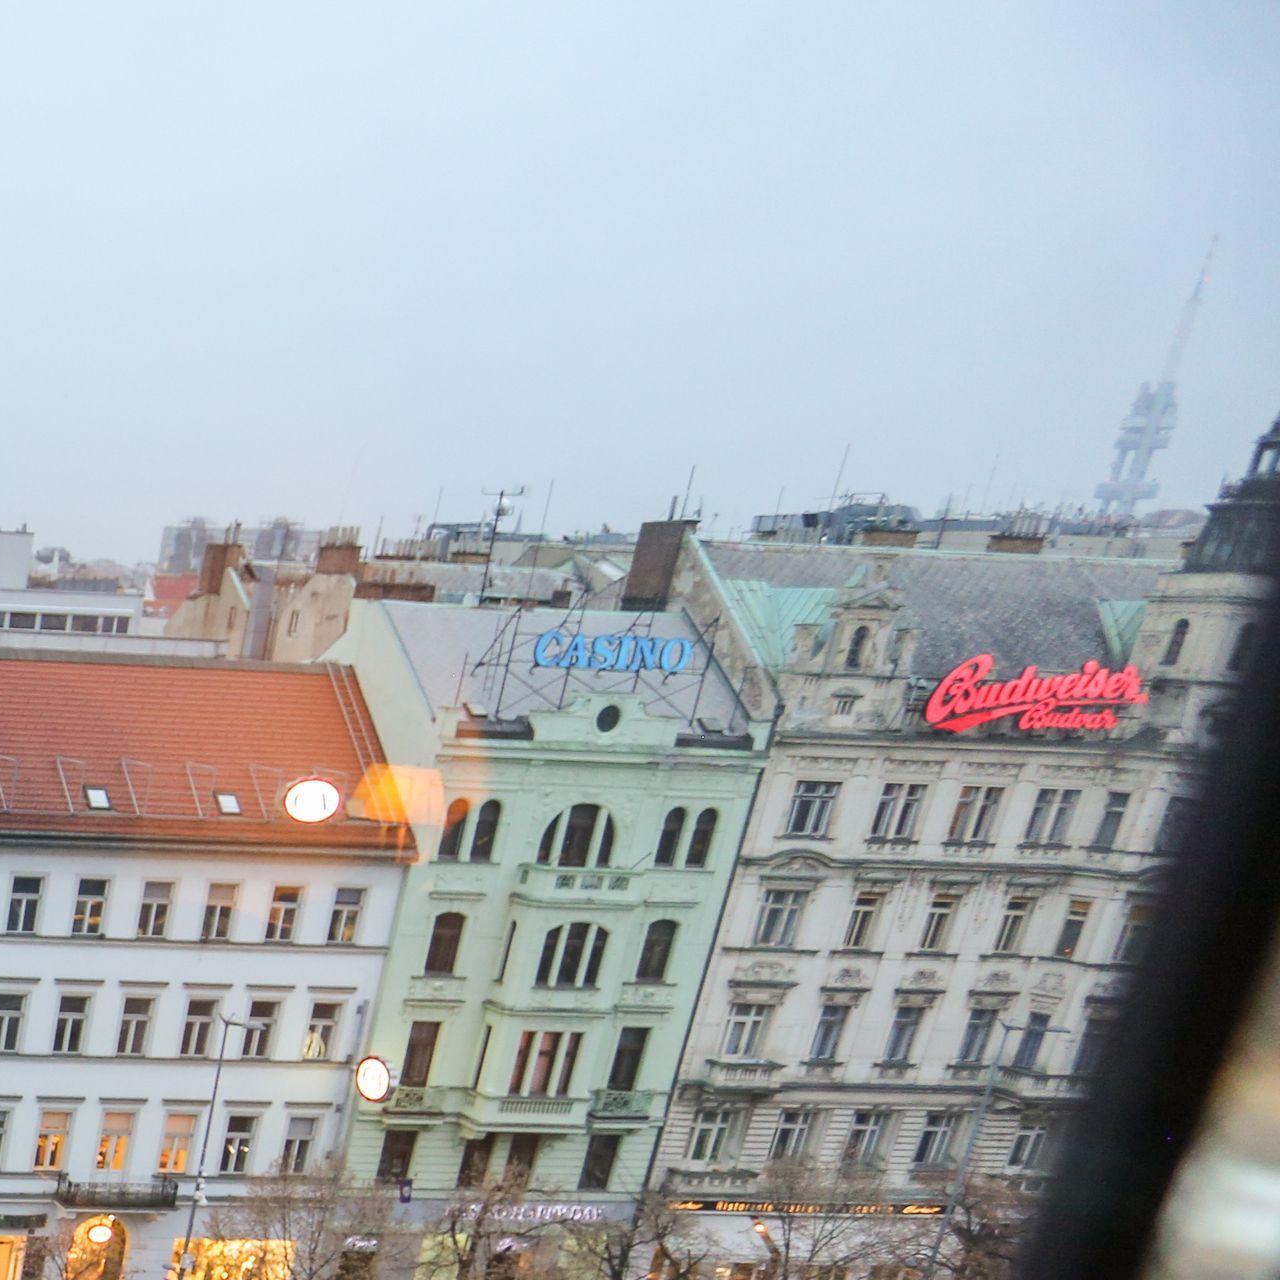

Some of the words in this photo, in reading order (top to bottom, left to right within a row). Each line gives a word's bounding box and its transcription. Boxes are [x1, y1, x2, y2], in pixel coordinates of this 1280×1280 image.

[534, 629, 693, 674] CASINO
[925, 653, 1148, 725] Budweiser
[1018, 697, 1119, 730] Budvar
